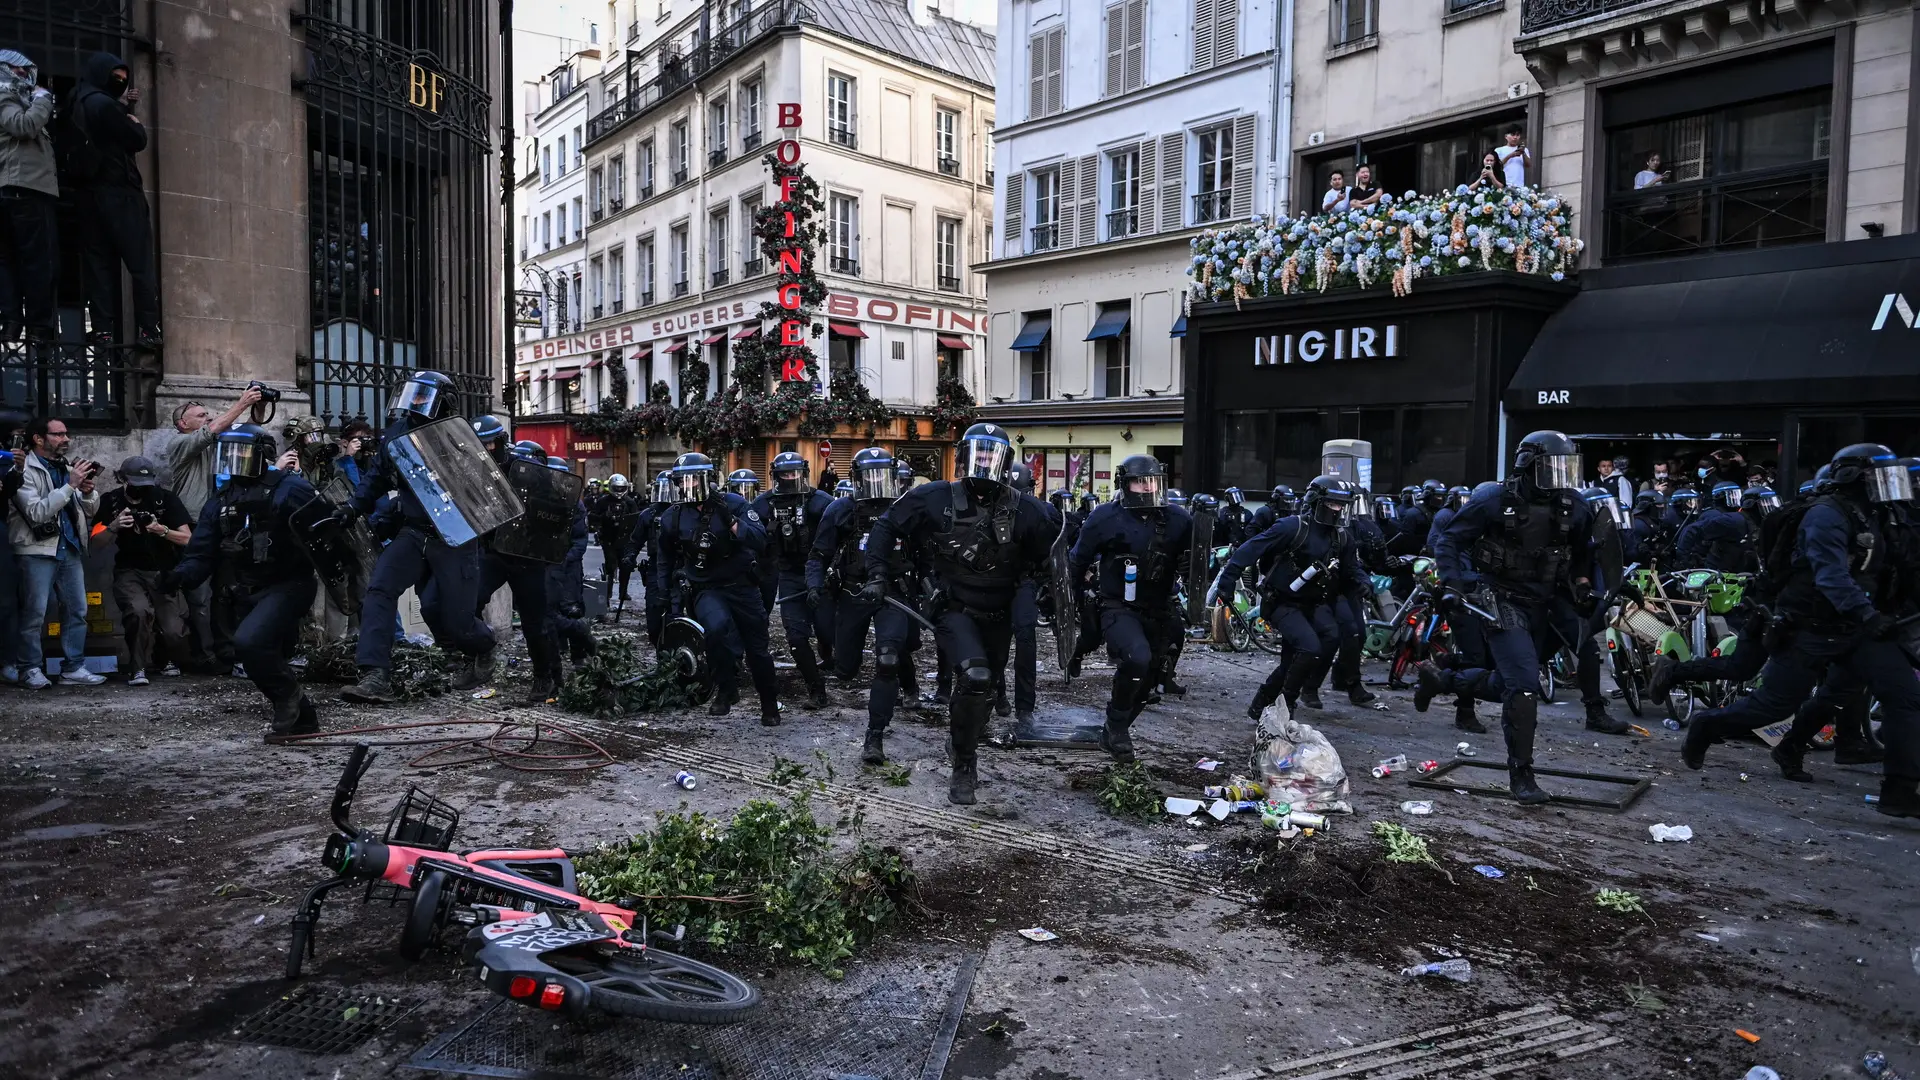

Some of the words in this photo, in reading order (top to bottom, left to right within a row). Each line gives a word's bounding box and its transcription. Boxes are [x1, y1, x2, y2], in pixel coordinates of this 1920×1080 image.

[409, 62, 447, 114] BF
[777, 103, 806, 382] BOFINGER
[533, 326, 634, 359] BOFINGER
[652, 302, 744, 336] SOUPERS
[828, 293, 989, 333] BOFIN
[1254, 324, 1398, 366] NIGIRI
[1537, 390, 1570, 404] BAR
[574, 441, 603, 451] BOFINGER
